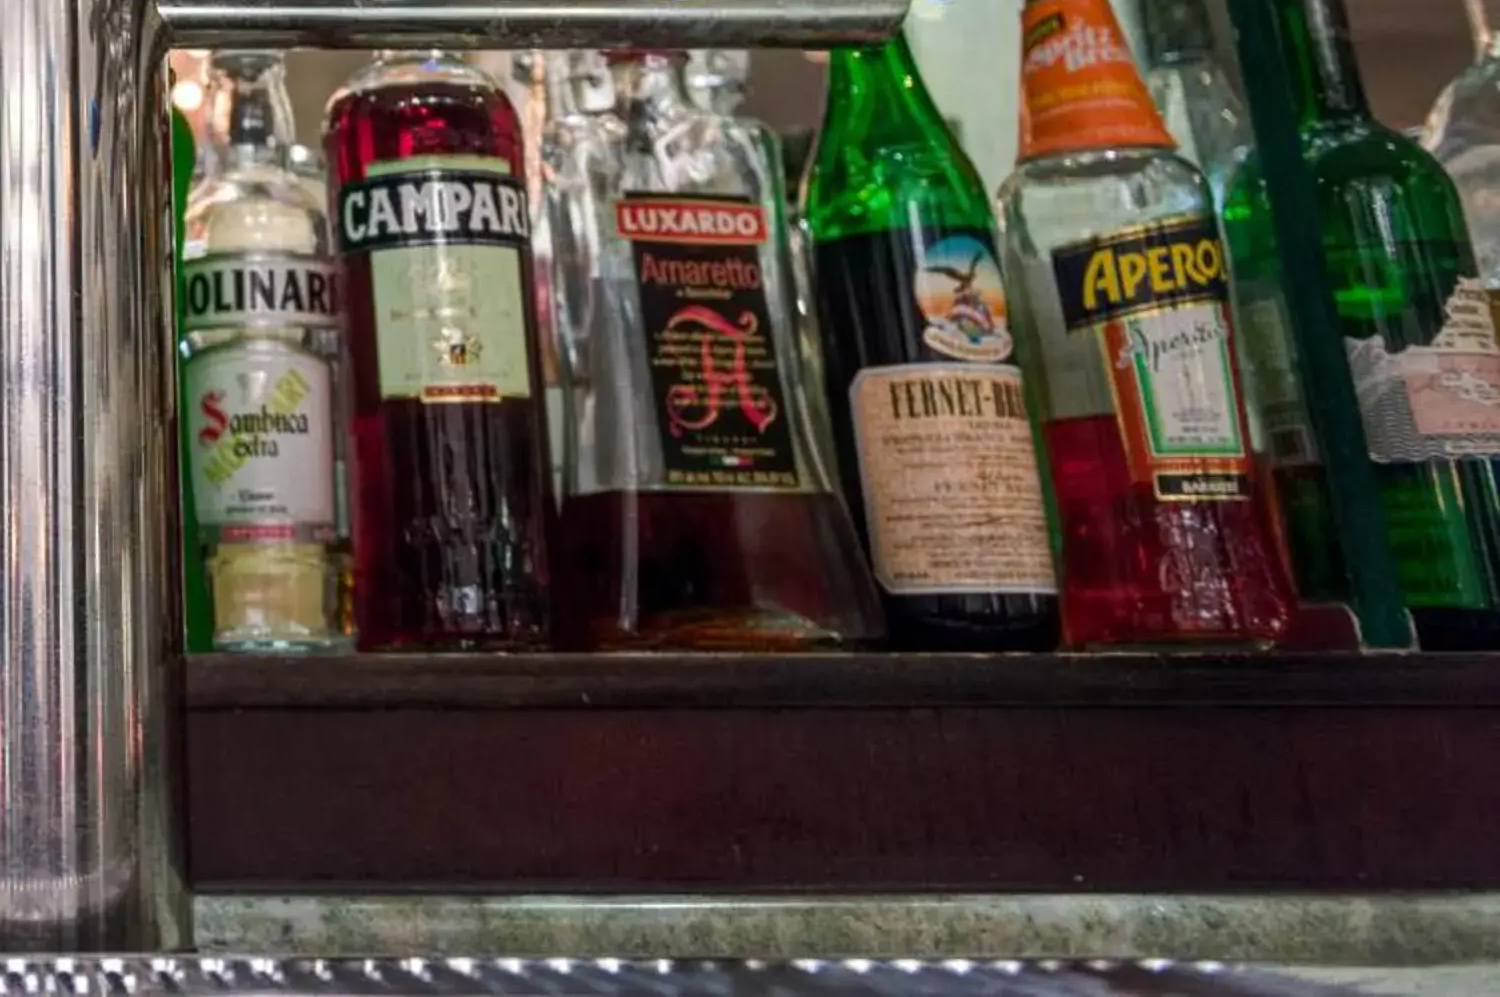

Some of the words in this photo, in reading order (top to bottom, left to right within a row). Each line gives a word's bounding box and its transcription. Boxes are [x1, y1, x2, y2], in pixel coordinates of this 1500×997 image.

[343, 180, 530, 244] CAMPARI
[621, 206, 760, 237] LUXARDO
[181, 267, 339, 316] OLINARI
[641, 253, 763, 290] Amaretto
